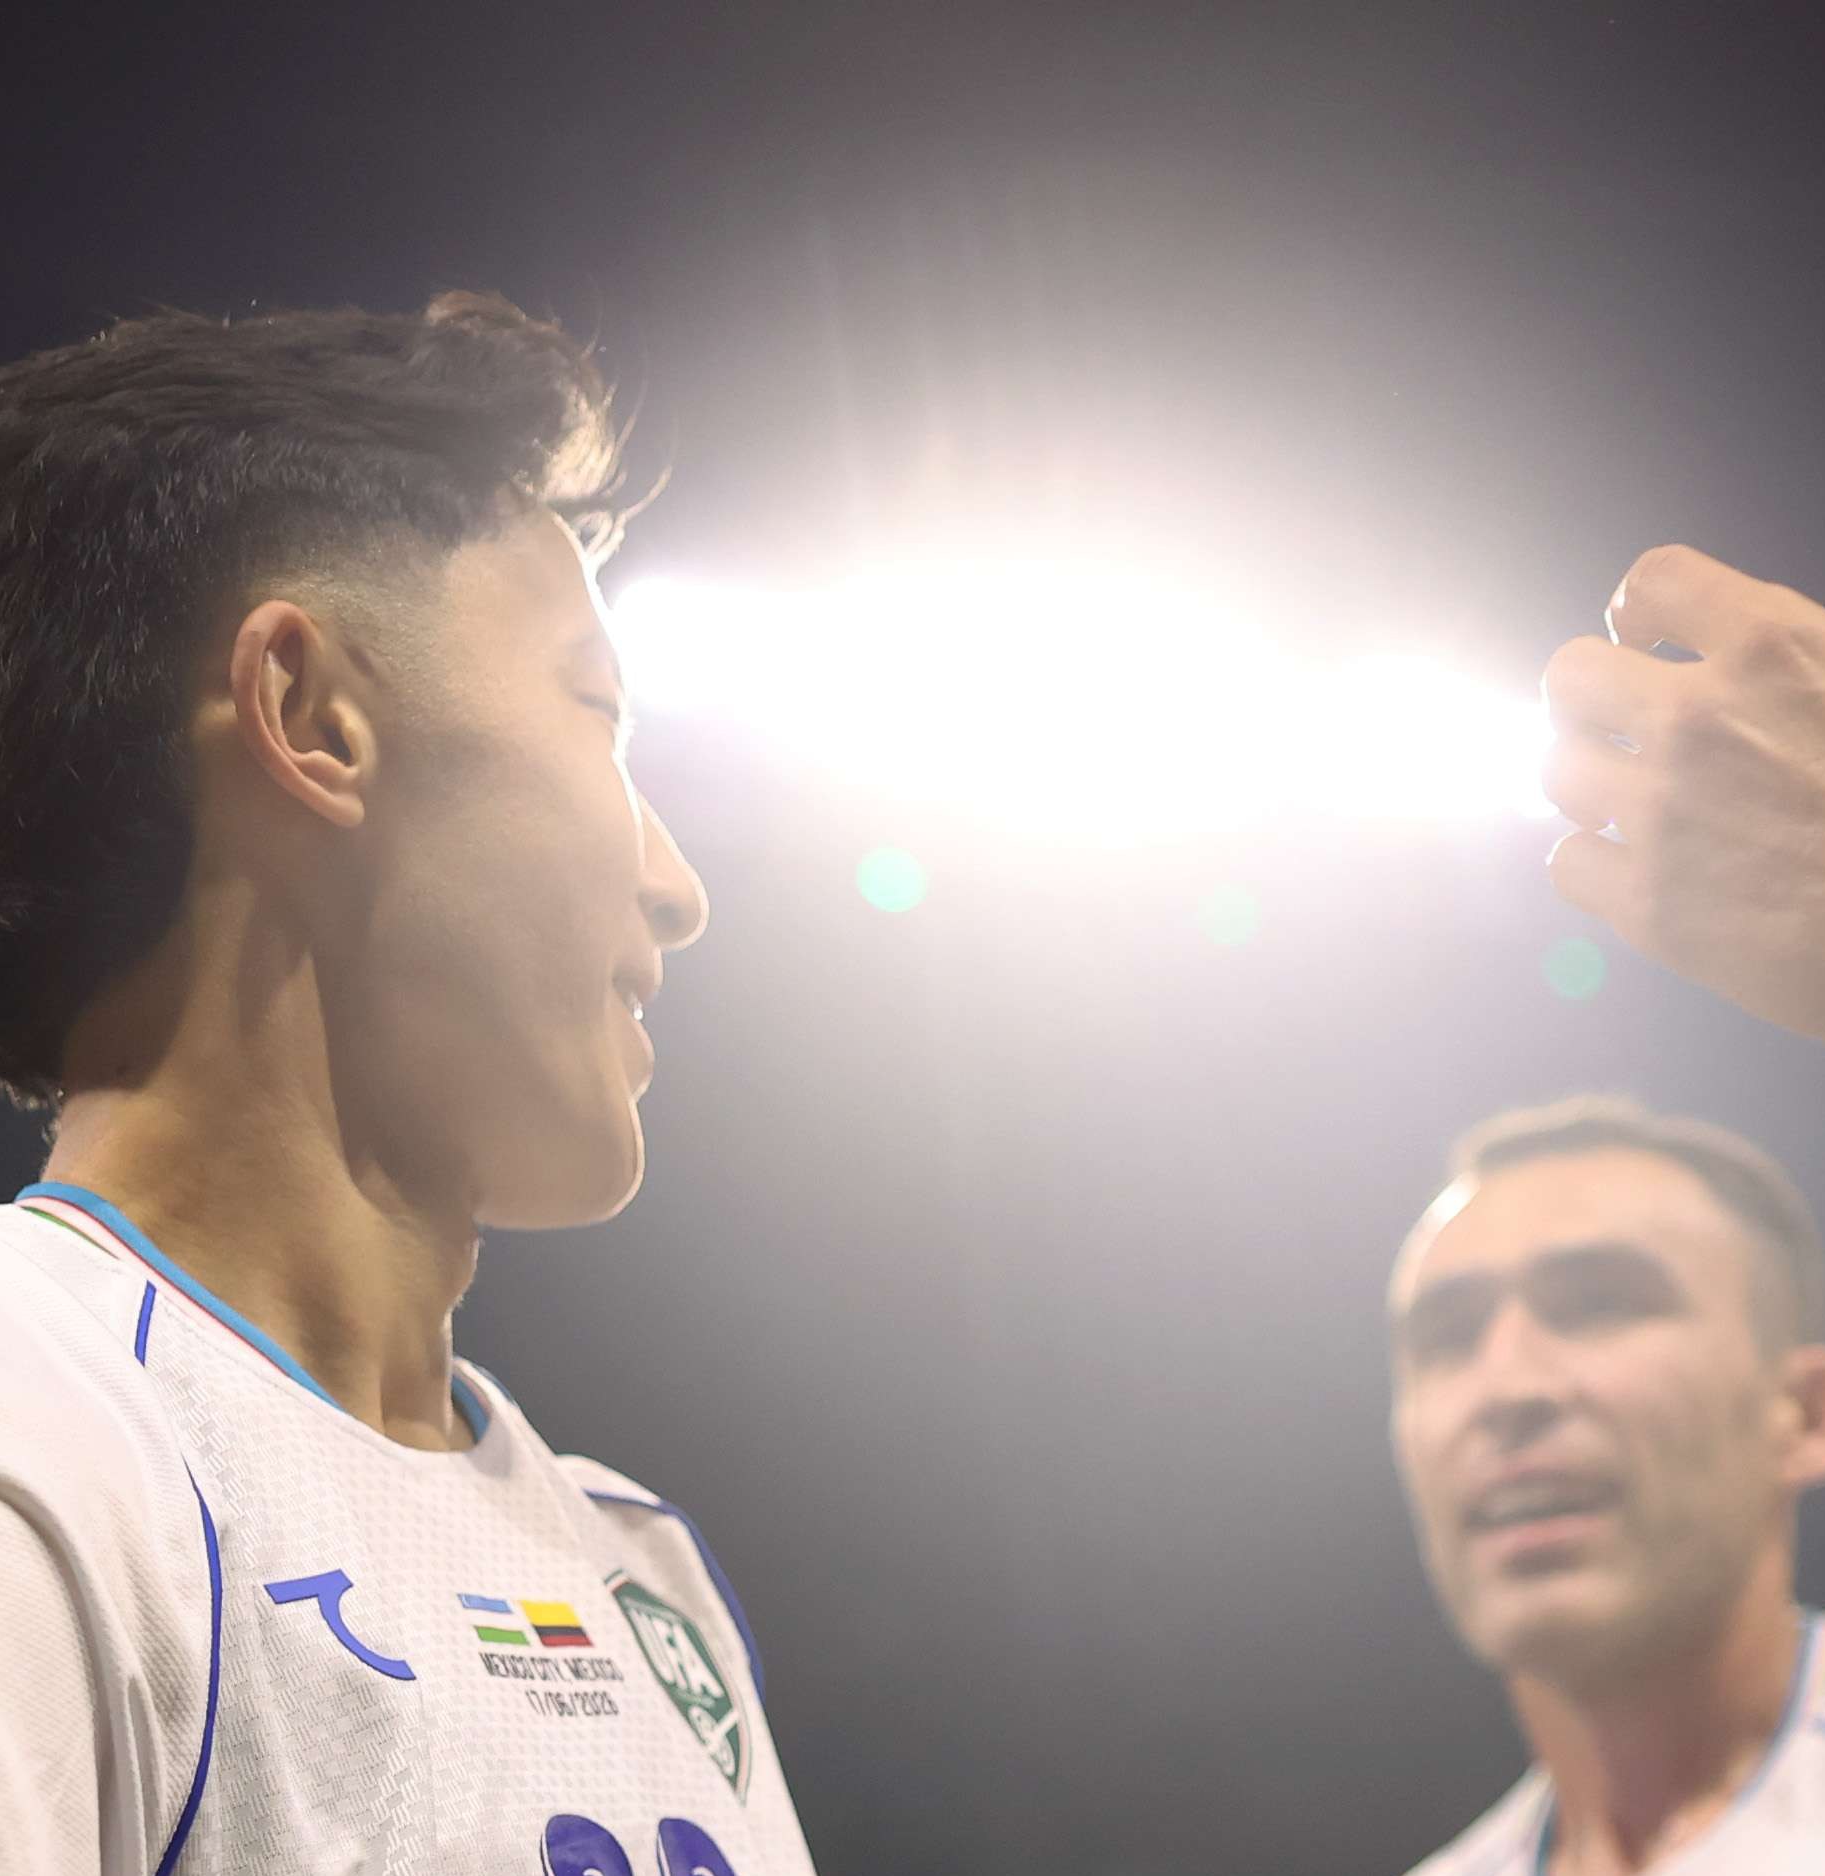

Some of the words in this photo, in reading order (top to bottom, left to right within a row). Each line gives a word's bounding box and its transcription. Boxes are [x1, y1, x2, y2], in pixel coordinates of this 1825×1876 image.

[478, 1652, 535, 1681] MEXICO
[563, 1657, 624, 1682] MEXICO
[628, 1606, 725, 1699] UFA
[525, 1689, 620, 1717] 17/06/2026
